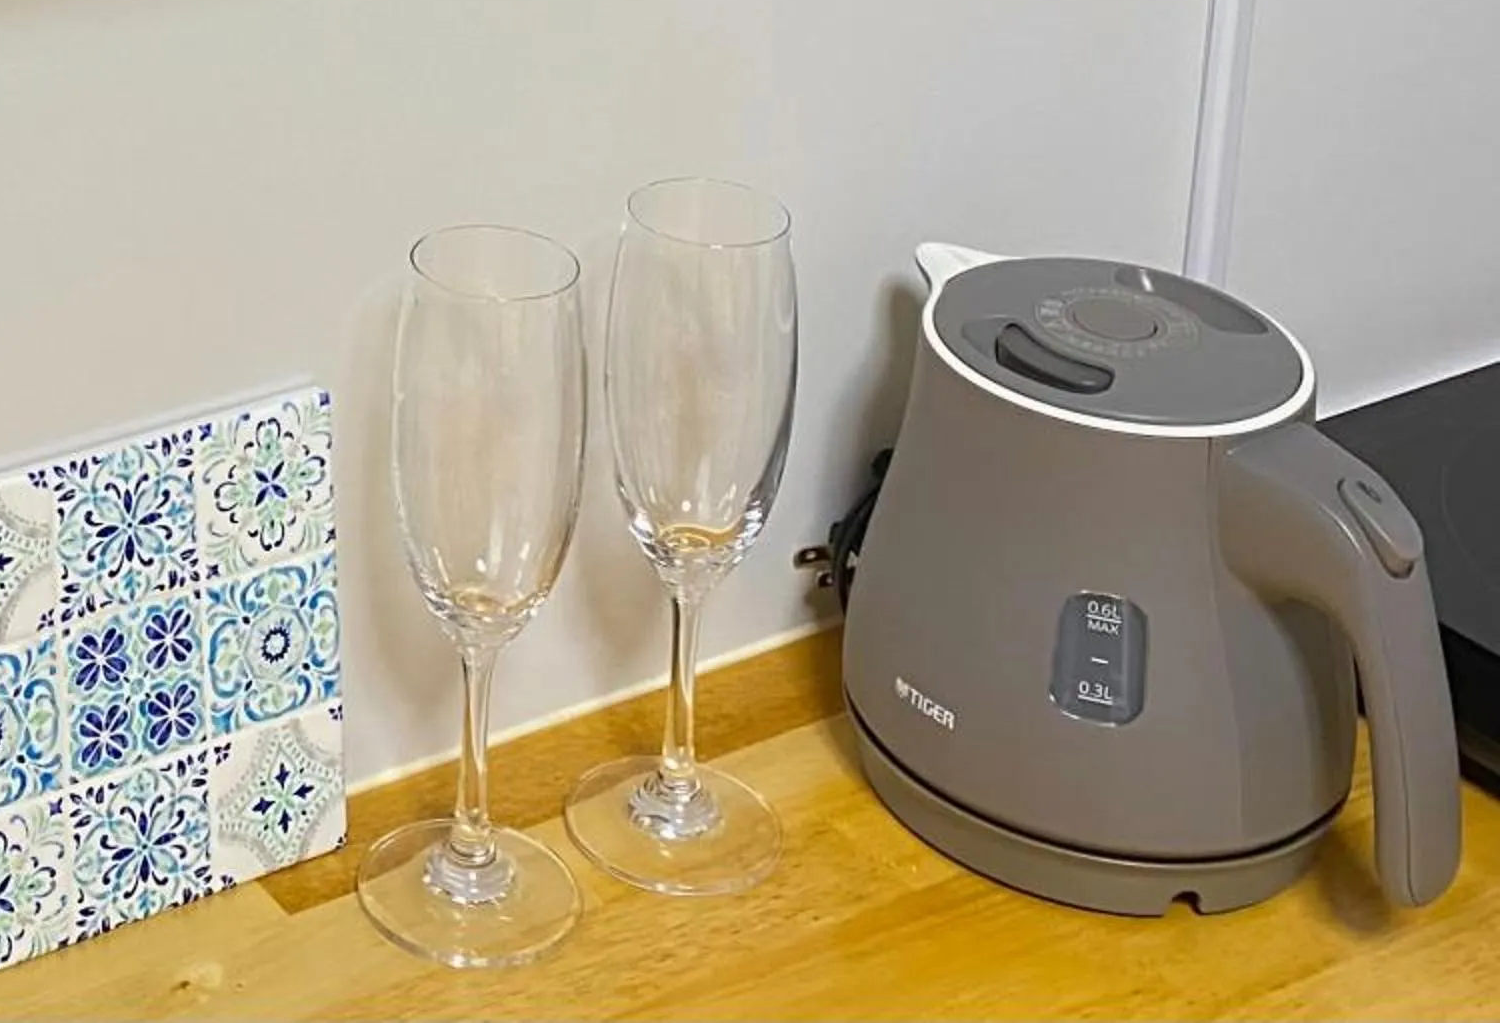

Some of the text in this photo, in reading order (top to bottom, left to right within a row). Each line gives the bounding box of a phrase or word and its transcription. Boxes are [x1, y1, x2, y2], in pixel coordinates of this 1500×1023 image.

[1087, 600, 1121, 619] 0.6L
[1087, 620, 1120, 635] MAX
[1078, 680, 1113, 700] 0.3L
[909, 689, 956, 730] TIGER
